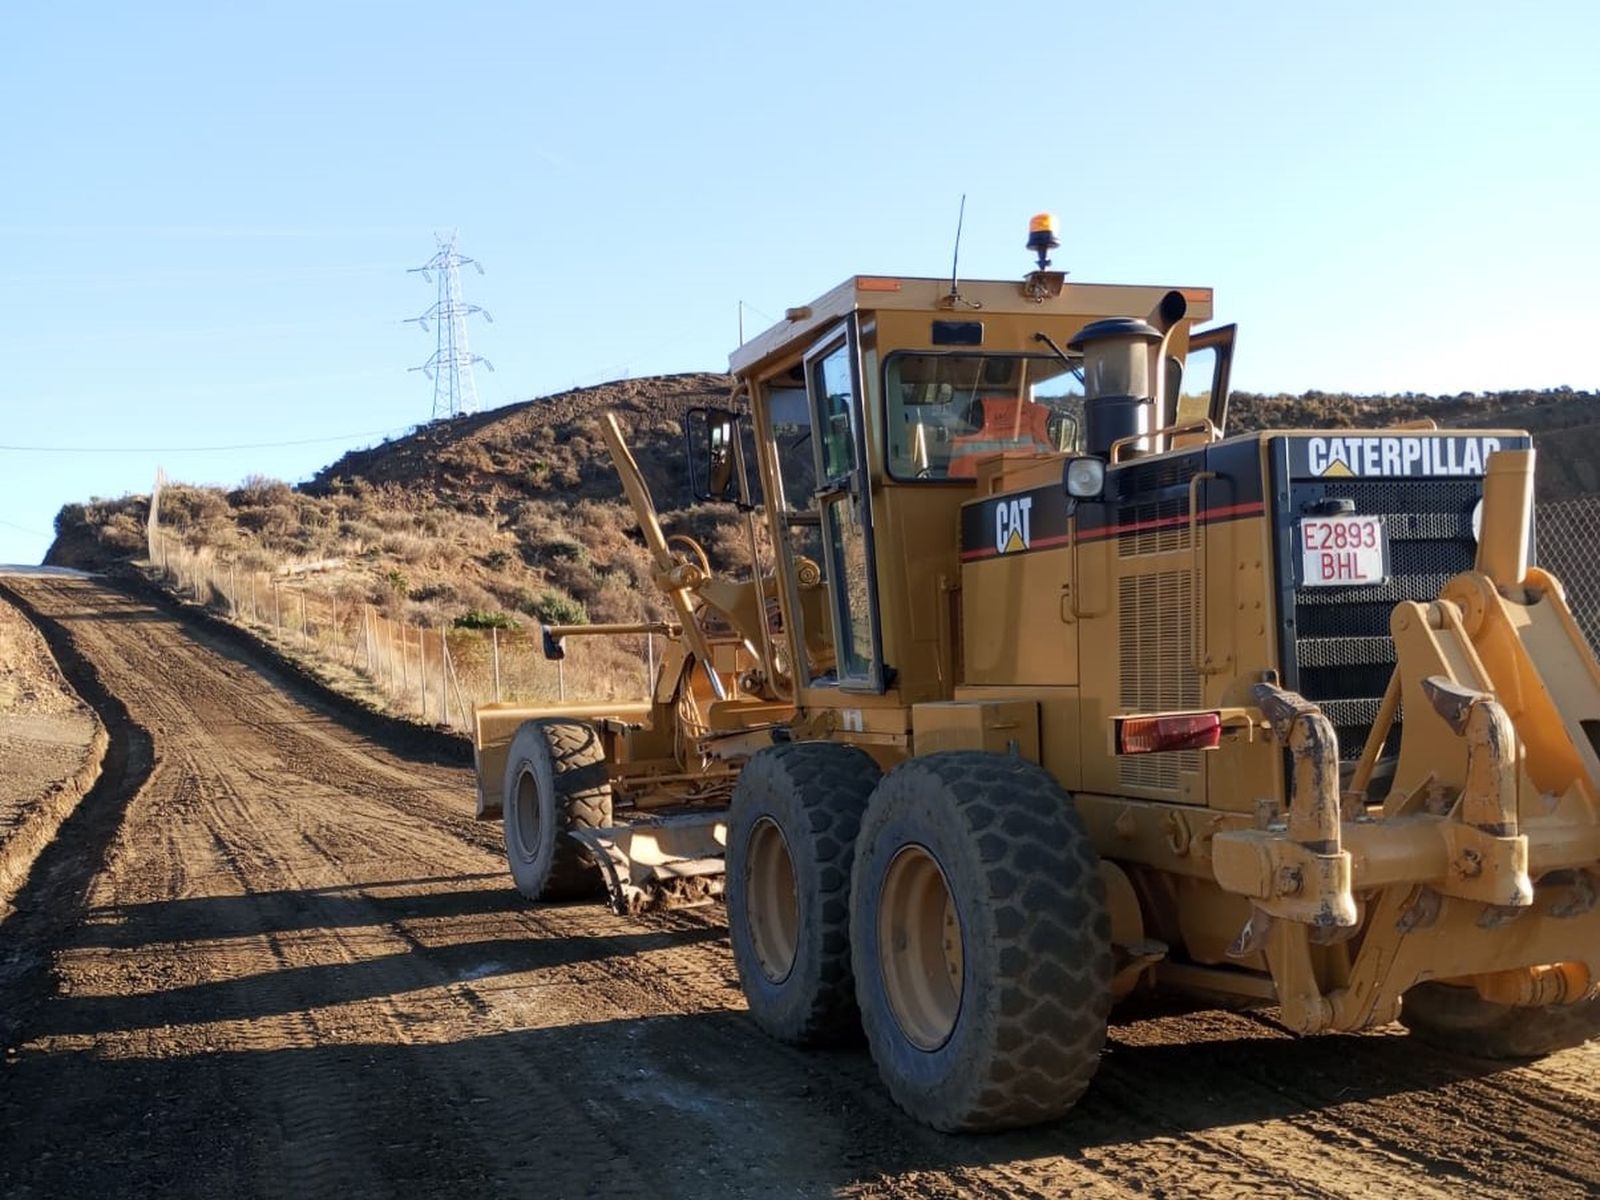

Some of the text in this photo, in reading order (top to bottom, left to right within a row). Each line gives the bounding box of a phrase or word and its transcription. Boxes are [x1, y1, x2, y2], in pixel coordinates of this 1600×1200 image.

[996, 497, 1032, 554] CAT
[1304, 522, 1376, 550] E2893
[1321, 552, 1367, 580] BHL
